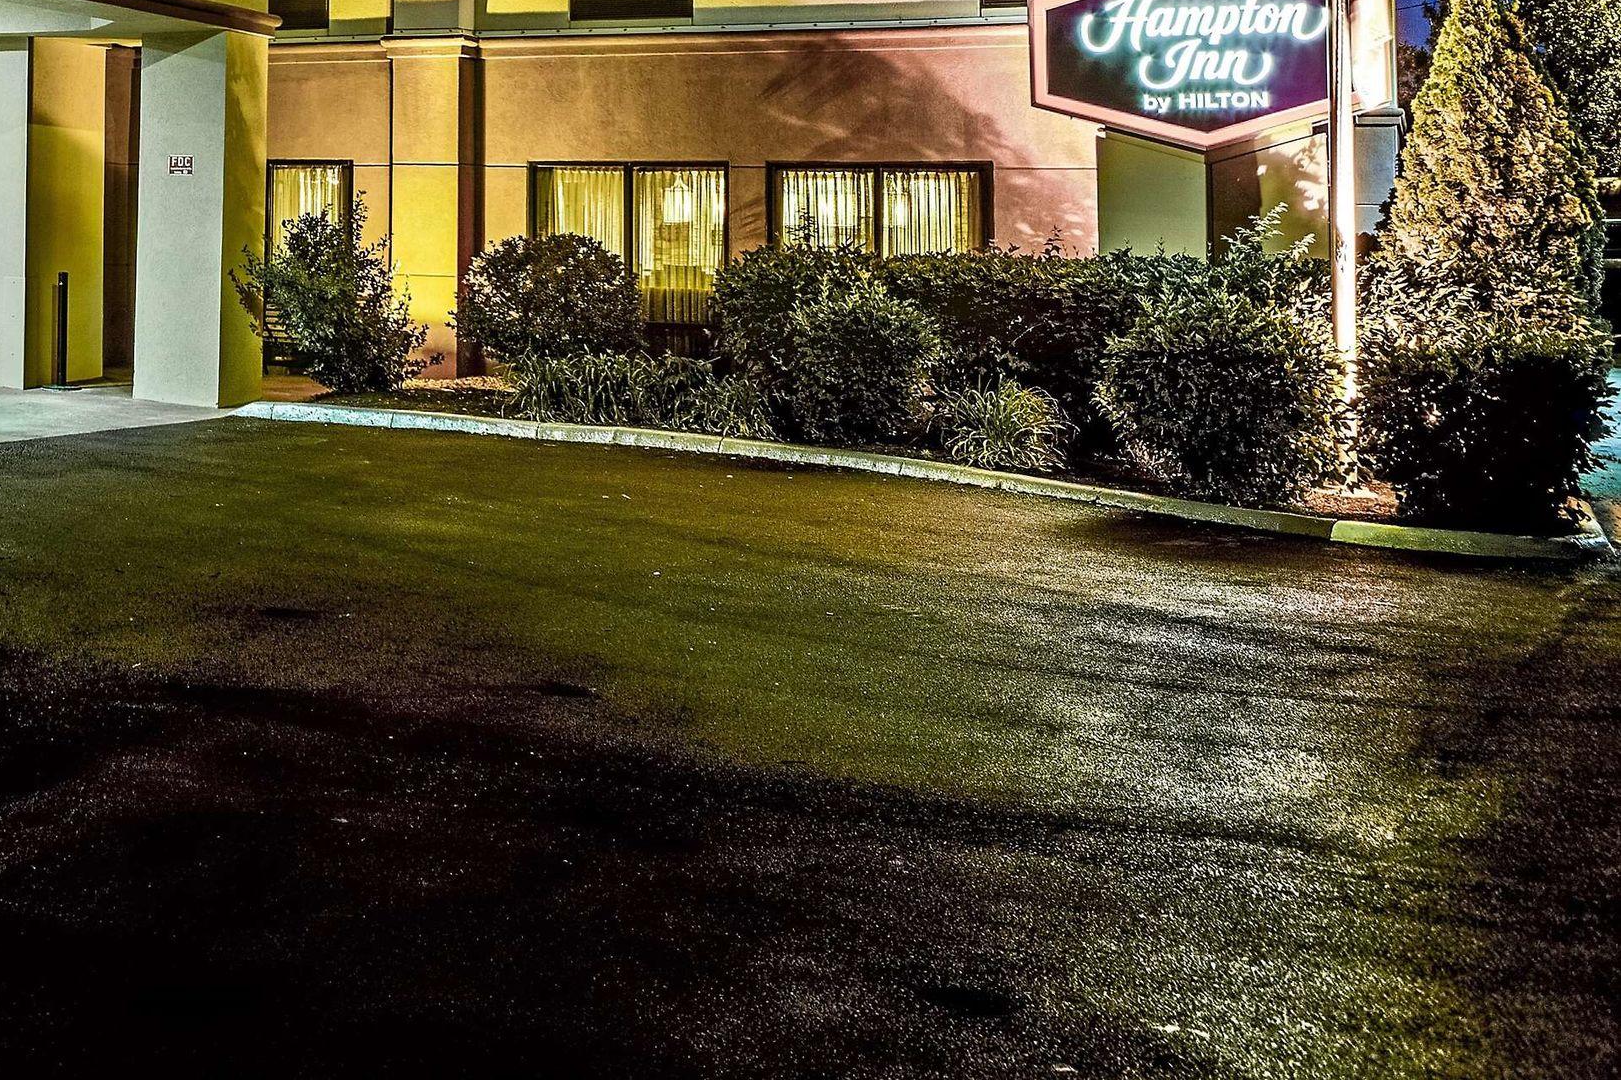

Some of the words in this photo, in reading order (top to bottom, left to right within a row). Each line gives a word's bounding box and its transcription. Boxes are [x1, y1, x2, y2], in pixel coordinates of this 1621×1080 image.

[1139, 38, 1271, 89] Inn
[1143, 93, 1170, 113] by
[1179, 91, 1270, 108] HILTON
